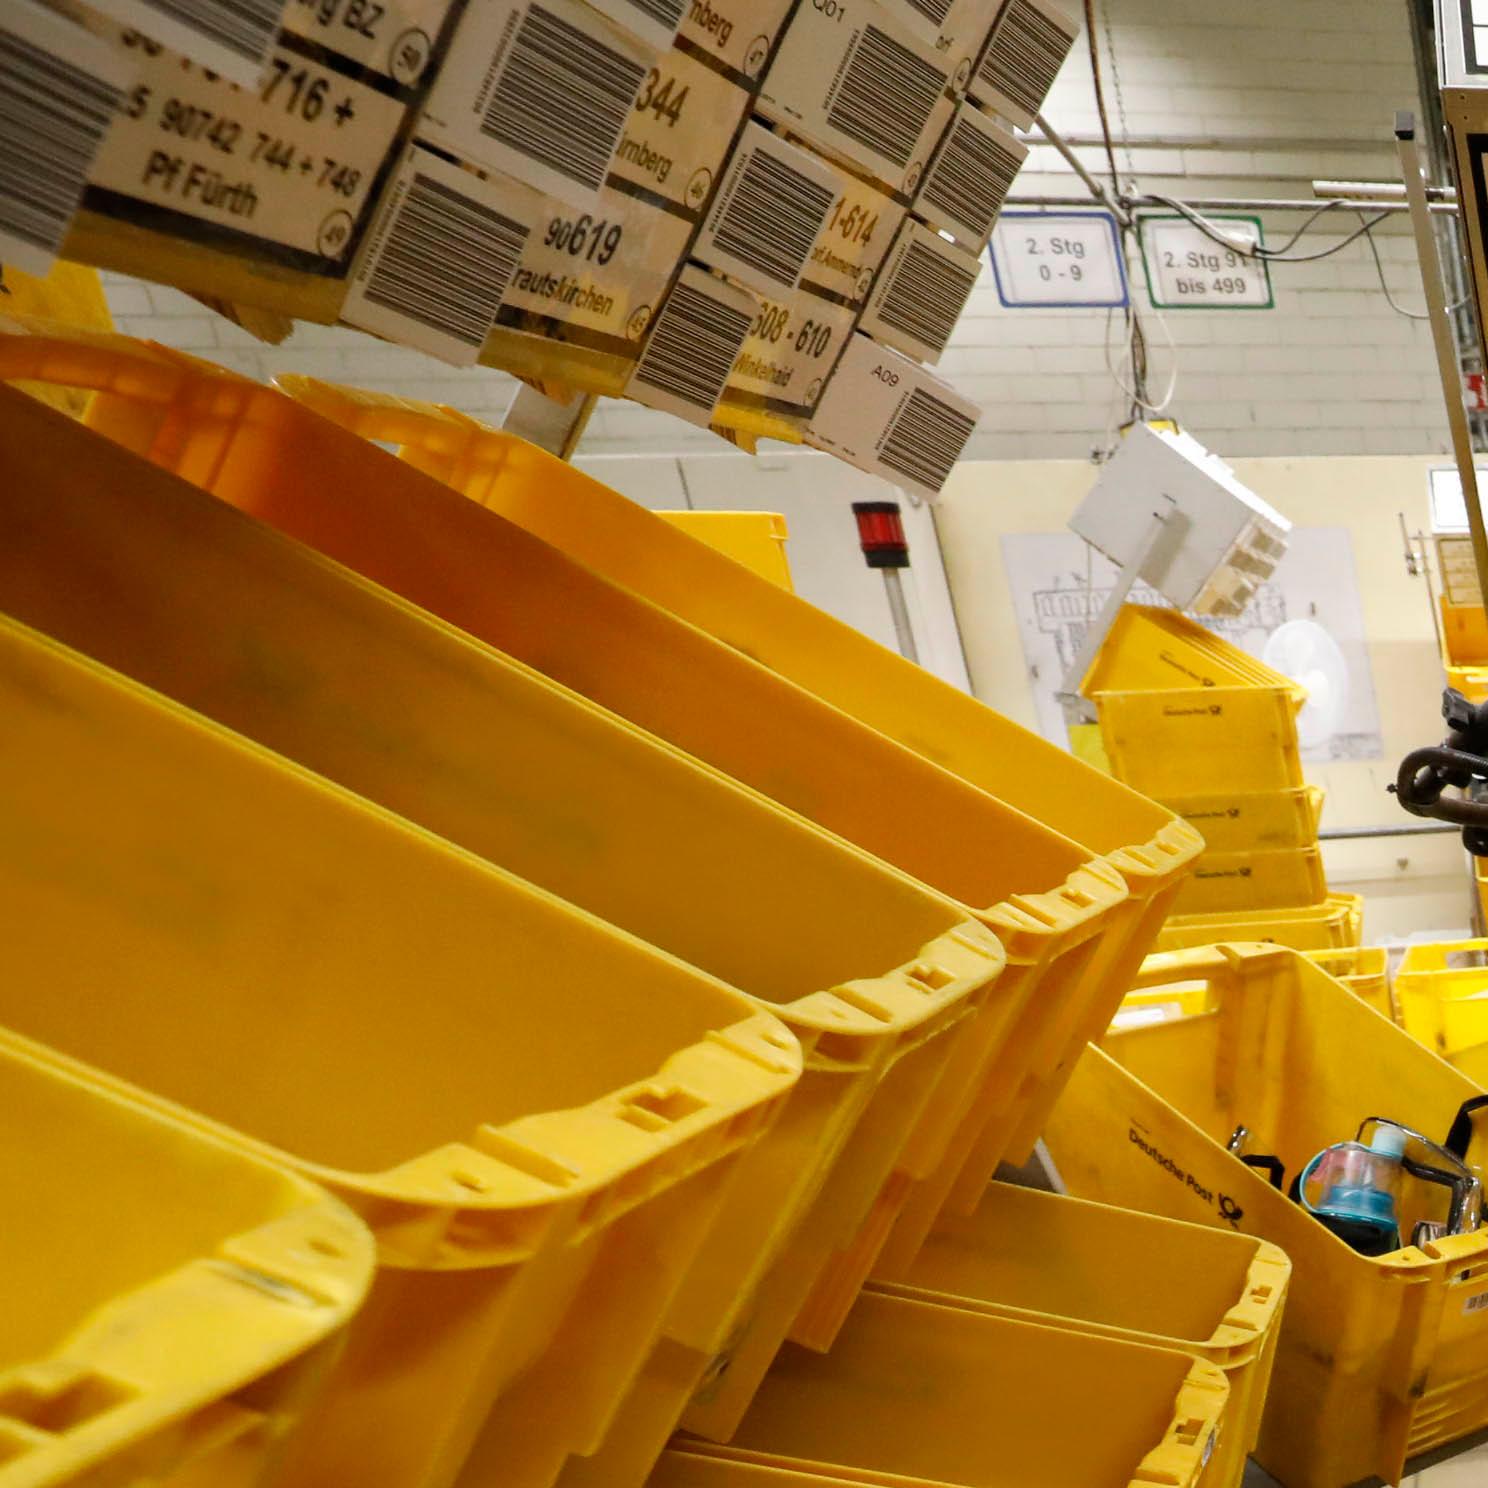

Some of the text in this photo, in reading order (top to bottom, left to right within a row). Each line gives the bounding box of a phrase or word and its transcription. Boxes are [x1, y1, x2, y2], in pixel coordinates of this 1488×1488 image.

[250, 131, 295, 175] 744
[317, 156, 362, 198] 748
[142, 150, 259, 218] Pf Fürth
[544, 213, 623, 266] 90619
[1027, 239, 1084, 258] 2. Stg
[1165, 252, 1220, 271] 2. Stg
[1176, 279, 1204, 294] bis
[872, 365, 900, 387] A09
[1129, 1128, 1212, 1204] Deutsche Post
